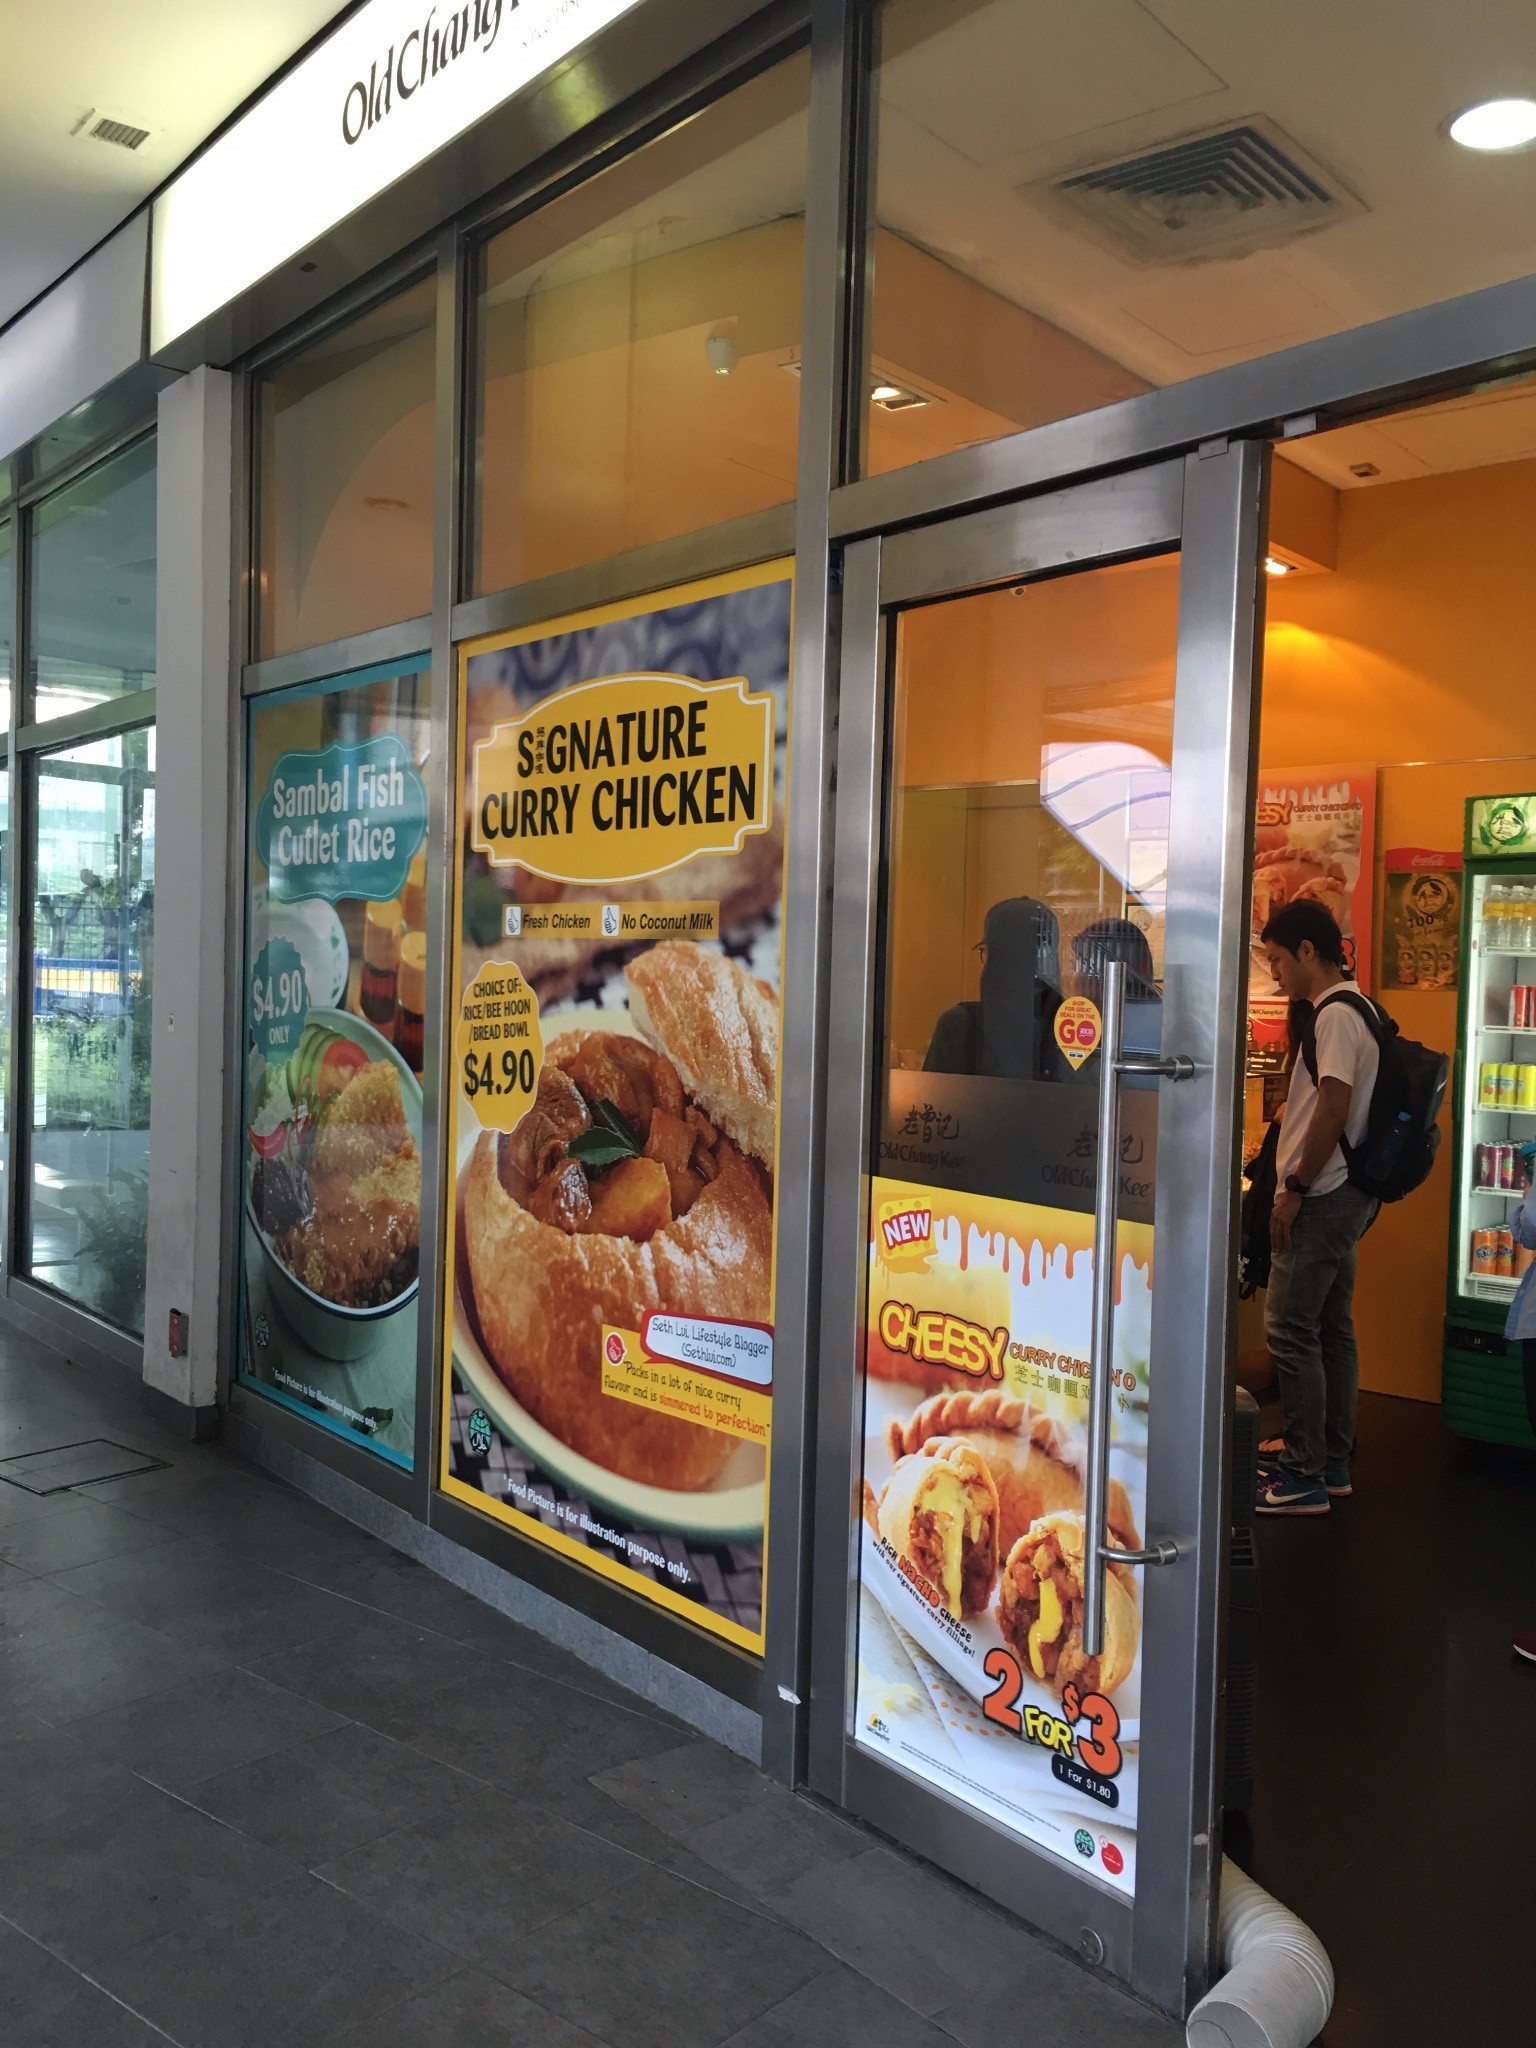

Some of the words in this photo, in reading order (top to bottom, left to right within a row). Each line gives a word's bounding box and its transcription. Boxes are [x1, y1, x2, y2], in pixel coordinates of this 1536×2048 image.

[273, 764, 350, 819] Sambal
[356, 757, 404, 811] Fish
[481, 783, 581, 840] CURRY
[592, 763, 756, 832] CHICKEN
[279, 819, 340, 867] Cutlet
[347, 817, 396, 864] Rice
[522, 913, 550, 931] Fresh
[551, 913, 591, 930] Chicken
[621, 914, 637, 930] No
[639, 913, 687, 930] Coconut
[689, 912, 714, 930] Milk
[253, 969, 302, 1022] $4.90
[463, 1001, 502, 1021] RICE/BEE
[504, 999, 531, 1017] HOON
[473, 979, 505, 998] CHOICE
[507, 977, 522, 994] OF:
[468, 1024, 502, 1044] /BREAD
[503, 1021, 530, 1039] BOWL
[464, 1048, 535, 1101] $4.90
[883, 1208, 932, 1249] NEW
[652, 1317, 674, 1336] Seth
[692, 1325, 732, 1350] Lifestyle
[734, 1334, 770, 1358] Blogger
[880, 1300, 1009, 1381] CHEESY
[1009, 1342, 1057, 1370] CURRY
[604, 1374, 630, 1394] flavour
[633, 1384, 649, 1400] and
[650, 1389, 658, 1402] is
[659, 1393, 701, 1417] simmered
[703, 1402, 713, 1420] to
[650, 1369, 660, 1383] in
[661, 1375, 667, 1386] a
[669, 1373, 681, 1390] lot
[683, 1379, 693, 1392] of
[695, 1383, 713, 1399] nice
[715, 1391, 742, 1412] curry
[507, 1478, 527, 1499] Food
[527, 1487, 556, 1513] Picture
[556, 1502, 565, 1518] is
[565, 1507, 578, 1525] for
[580, 1513, 626, 1549] illustration
[627, 1541, 666, 1569] purpose
[667, 1561, 691, 1584] only.
[872, 1540, 885, 1559] with
[886, 1559, 897, 1573] our
[897, 1573, 926, 1608] signature
[927, 1608, 945, 1629] curry
[983, 1647, 1023, 1736] 2
[1023, 1705, 1074, 1759] FOR
[1059, 1764, 1064, 1774] 1
[1086, 1779, 1111, 1799] $1.80
